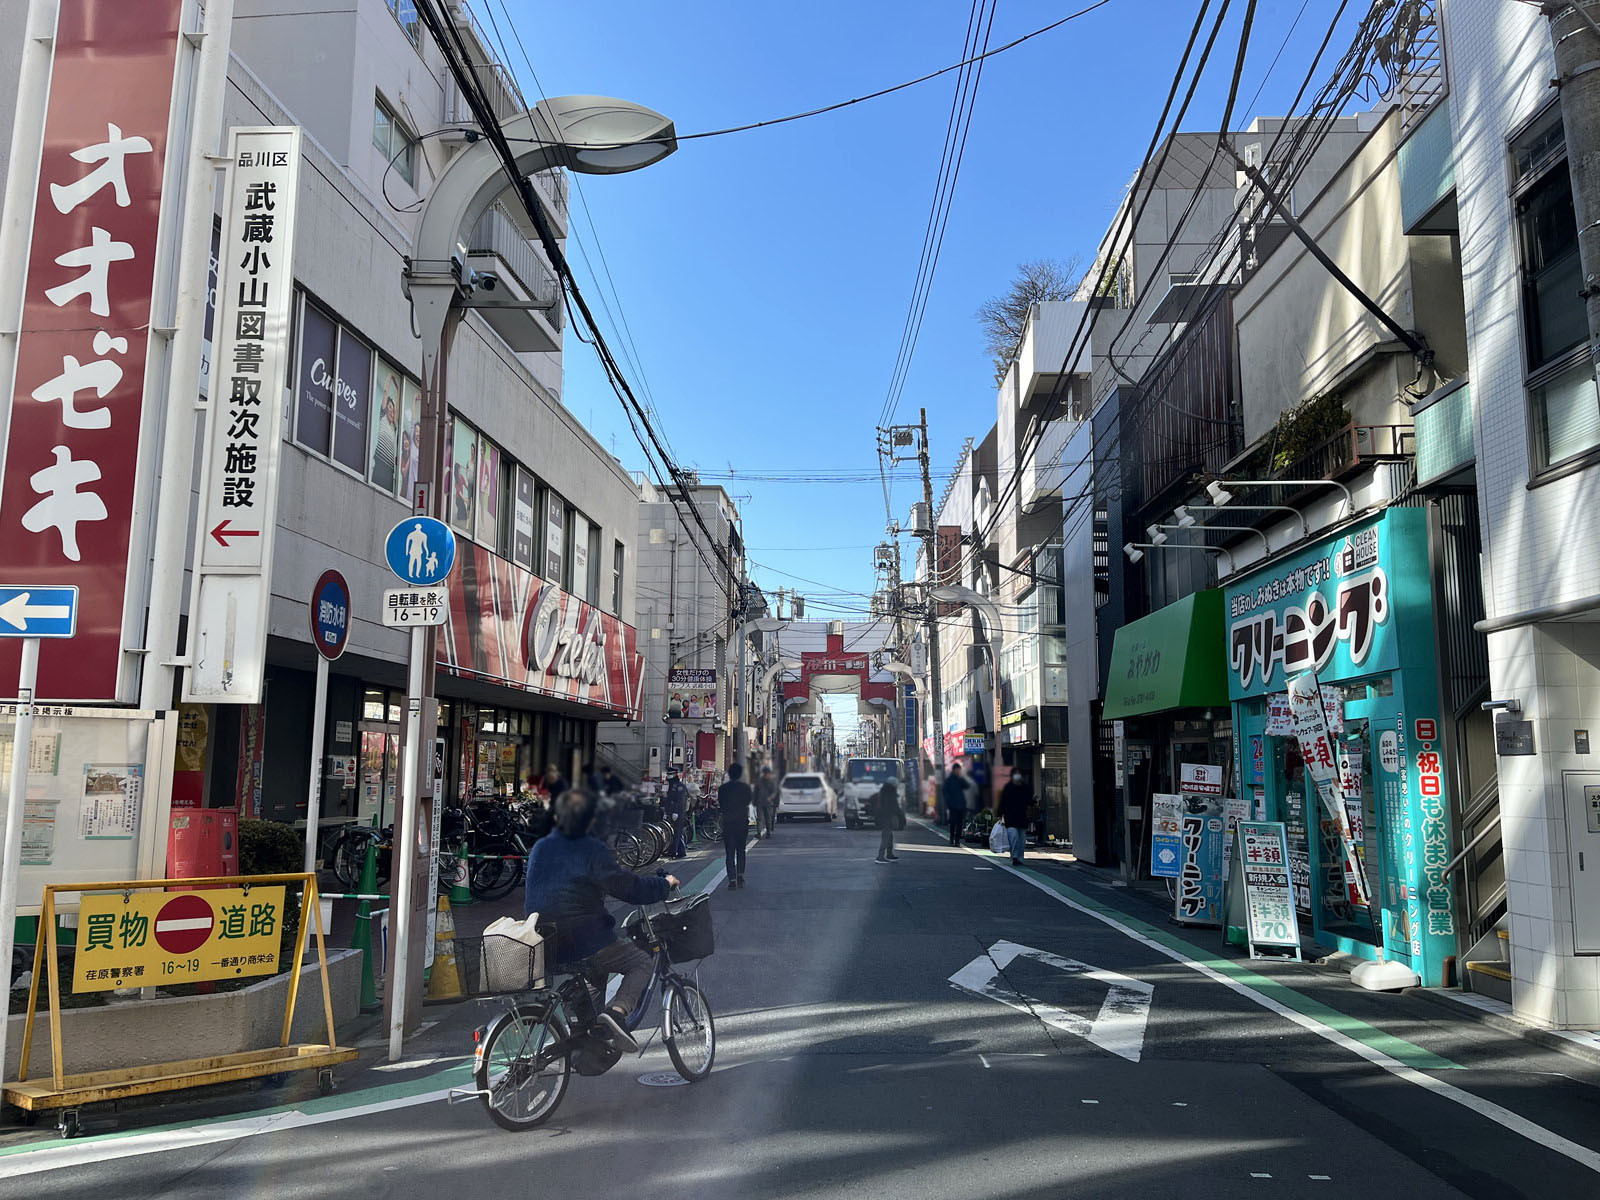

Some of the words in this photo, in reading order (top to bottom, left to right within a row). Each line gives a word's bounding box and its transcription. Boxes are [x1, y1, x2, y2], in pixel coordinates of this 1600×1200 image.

[238, 152, 288, 167] 品川区
[21, 122, 153, 561] オオゼキ
[222, 181, 277, 508] 武蔵小山図書取次施設
[1355, 531, 1377, 546] CLEAN
[1355, 541, 1377, 560] HOUSE
[388, 592, 444, 607] 自転車を除く
[319, 599, 346, 629] 消防水利
[393, 607, 439, 622] 16-19
[528, 585, 606, 686] Ozeki
[1231, 567, 1387, 688] クリーニング
[1248, 846, 1281, 864] 半額
[1181, 817, 1206, 917] クリーニング
[1248, 873, 1287, 884] 新規入会
[1258, 903, 1290, 920] 半額
[84, 911, 149, 951] 買物
[218, 902, 276, 940] 道路
[85, 965, 145, 981] 荏原警察署
[211, 953, 275, 968] 一番通り商栄会
